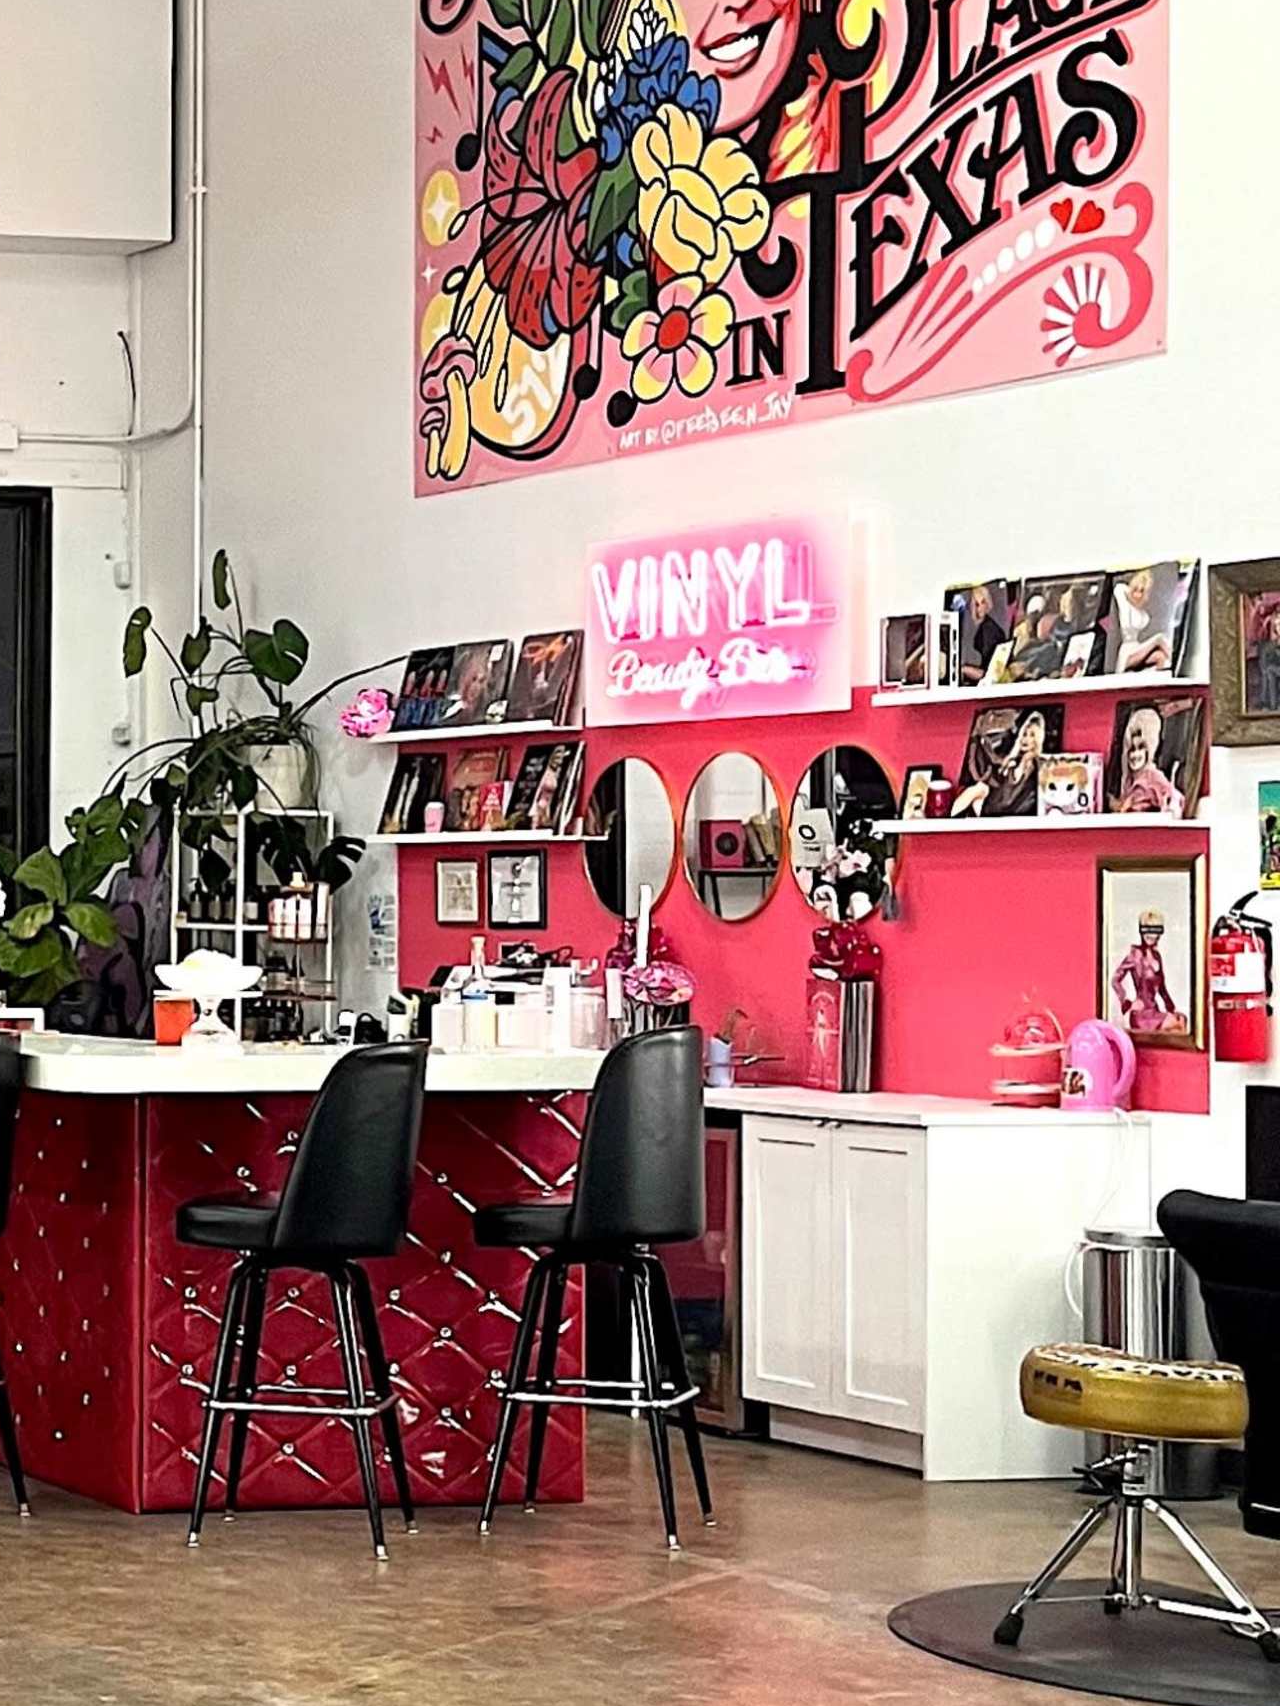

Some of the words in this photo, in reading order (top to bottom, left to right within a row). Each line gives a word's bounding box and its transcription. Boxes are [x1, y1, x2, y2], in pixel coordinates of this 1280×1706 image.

[740, 28, 1139, 395] TEXAS
[726, 309, 791, 388] IN
[592, 538, 811, 643] VINYL
[606, 644, 715, 710] Beauty
[718, 637, 792, 684] Bar
